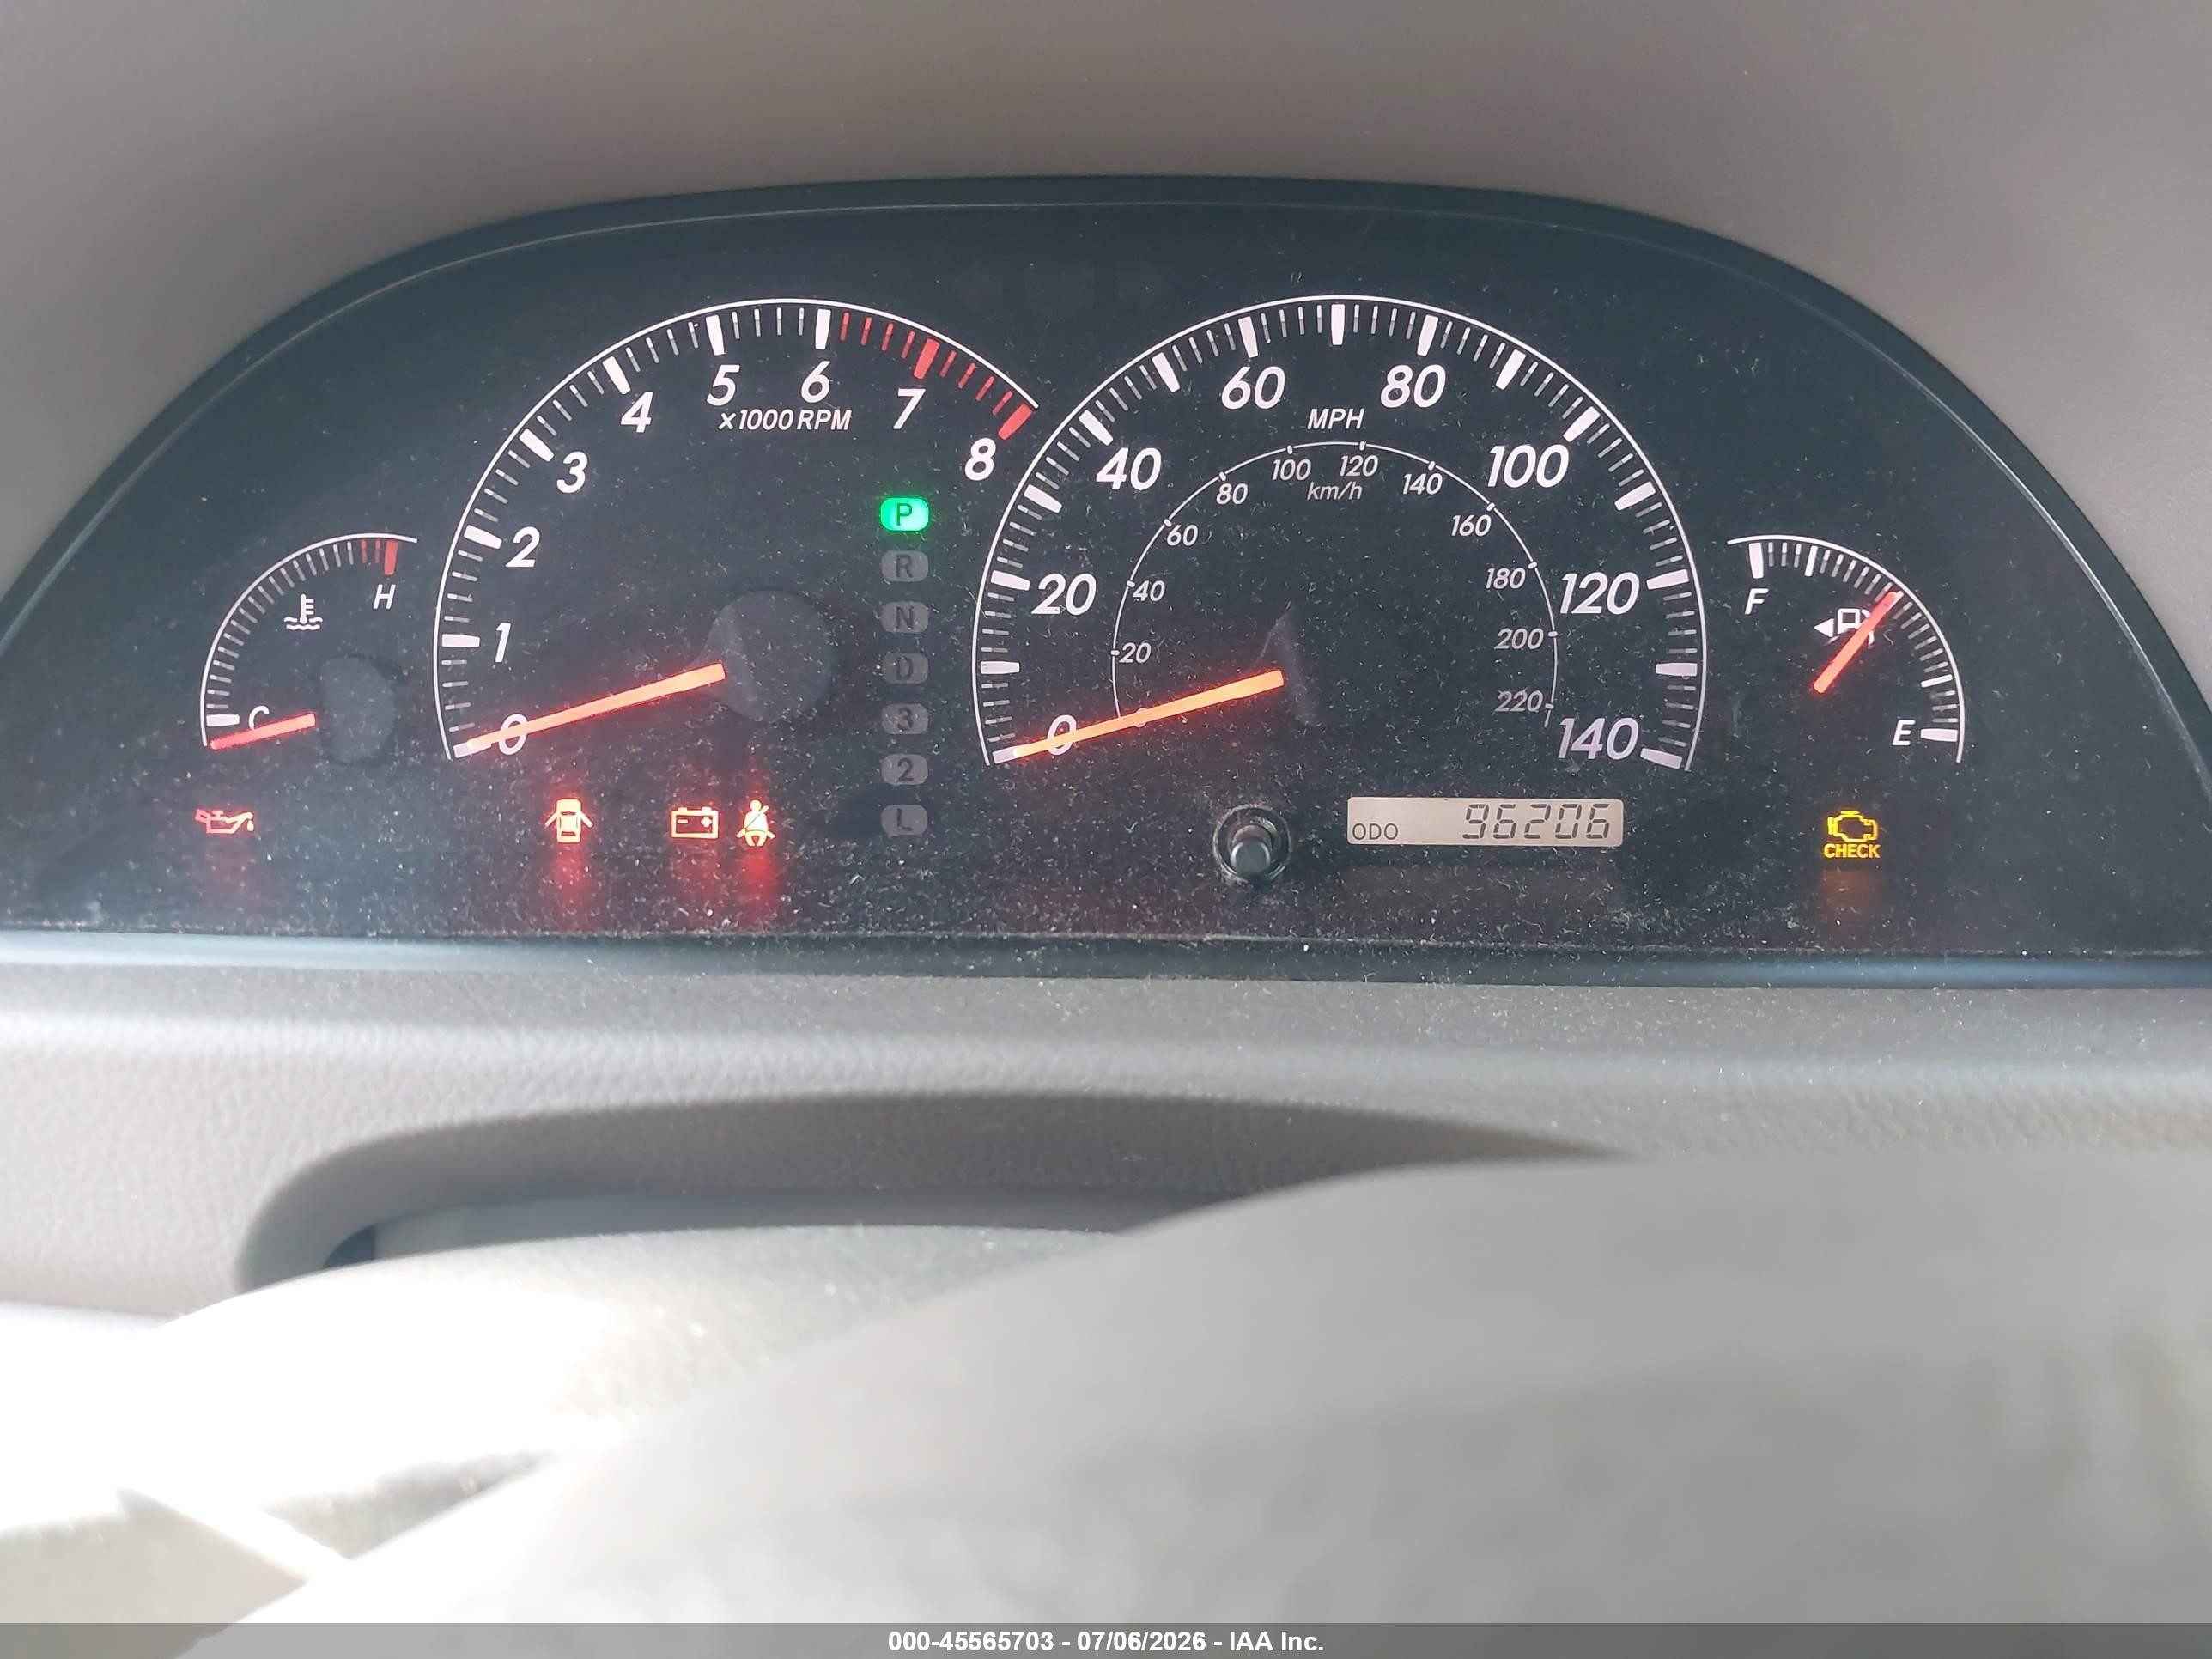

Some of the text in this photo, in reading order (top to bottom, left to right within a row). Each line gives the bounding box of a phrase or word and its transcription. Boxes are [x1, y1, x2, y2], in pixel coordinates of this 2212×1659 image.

[707, 364, 739, 406] 5
[800, 361, 830, 403] 6
[1221, 366, 1285, 410] 60
[1380, 364, 1446, 408] 80
[621, 392, 653, 433] 4
[799, 410, 852, 430] RPM
[892, 387, 926, 429] 7
[1307, 408, 1365, 429] MPH
[964, 437, 996, 481] 8
[1095, 447, 1162, 491] 40
[1271, 459, 1312, 482] 100
[1340, 454, 1378, 477] 120
[1487, 444, 1570, 488] 100
[556, 451, 588, 493] 3
[1402, 472, 1443, 495] 140
[1216, 483, 1249, 505] 80
[1306, 481, 1363, 501] km/h
[896, 503, 913, 526] P
[1450, 514, 1492, 537] 160
[505, 526, 541, 568] 2
[1166, 524, 1199, 547] 60
[896, 555, 914, 578] R
[1485, 568, 1526, 589] 180
[373, 584, 396, 609] H
[1031, 573, 1097, 616] 20
[1133, 580, 1166, 603] 40
[1559, 571, 1641, 615] 120
[1744, 588, 1770, 615] F
[896, 606, 915, 629] N
[495, 623, 512, 663] 1
[1494, 628, 1545, 650] 200
[1119, 642, 1152, 663] 20
[896, 659, 914, 681] D
[1494, 690, 1544, 712] 220
[896, 708, 914, 731] 3
[497, 714, 529, 756] 0
[1047, 714, 1078, 757] 0
[1557, 718, 1640, 760] 140
[1892, 720, 1917, 745] E
[896, 758, 915, 782] 2
[896, 809, 913, 832] L
[1352, 804, 1610, 841] ODO 96206
[1823, 842, 1881, 860] CHECK
